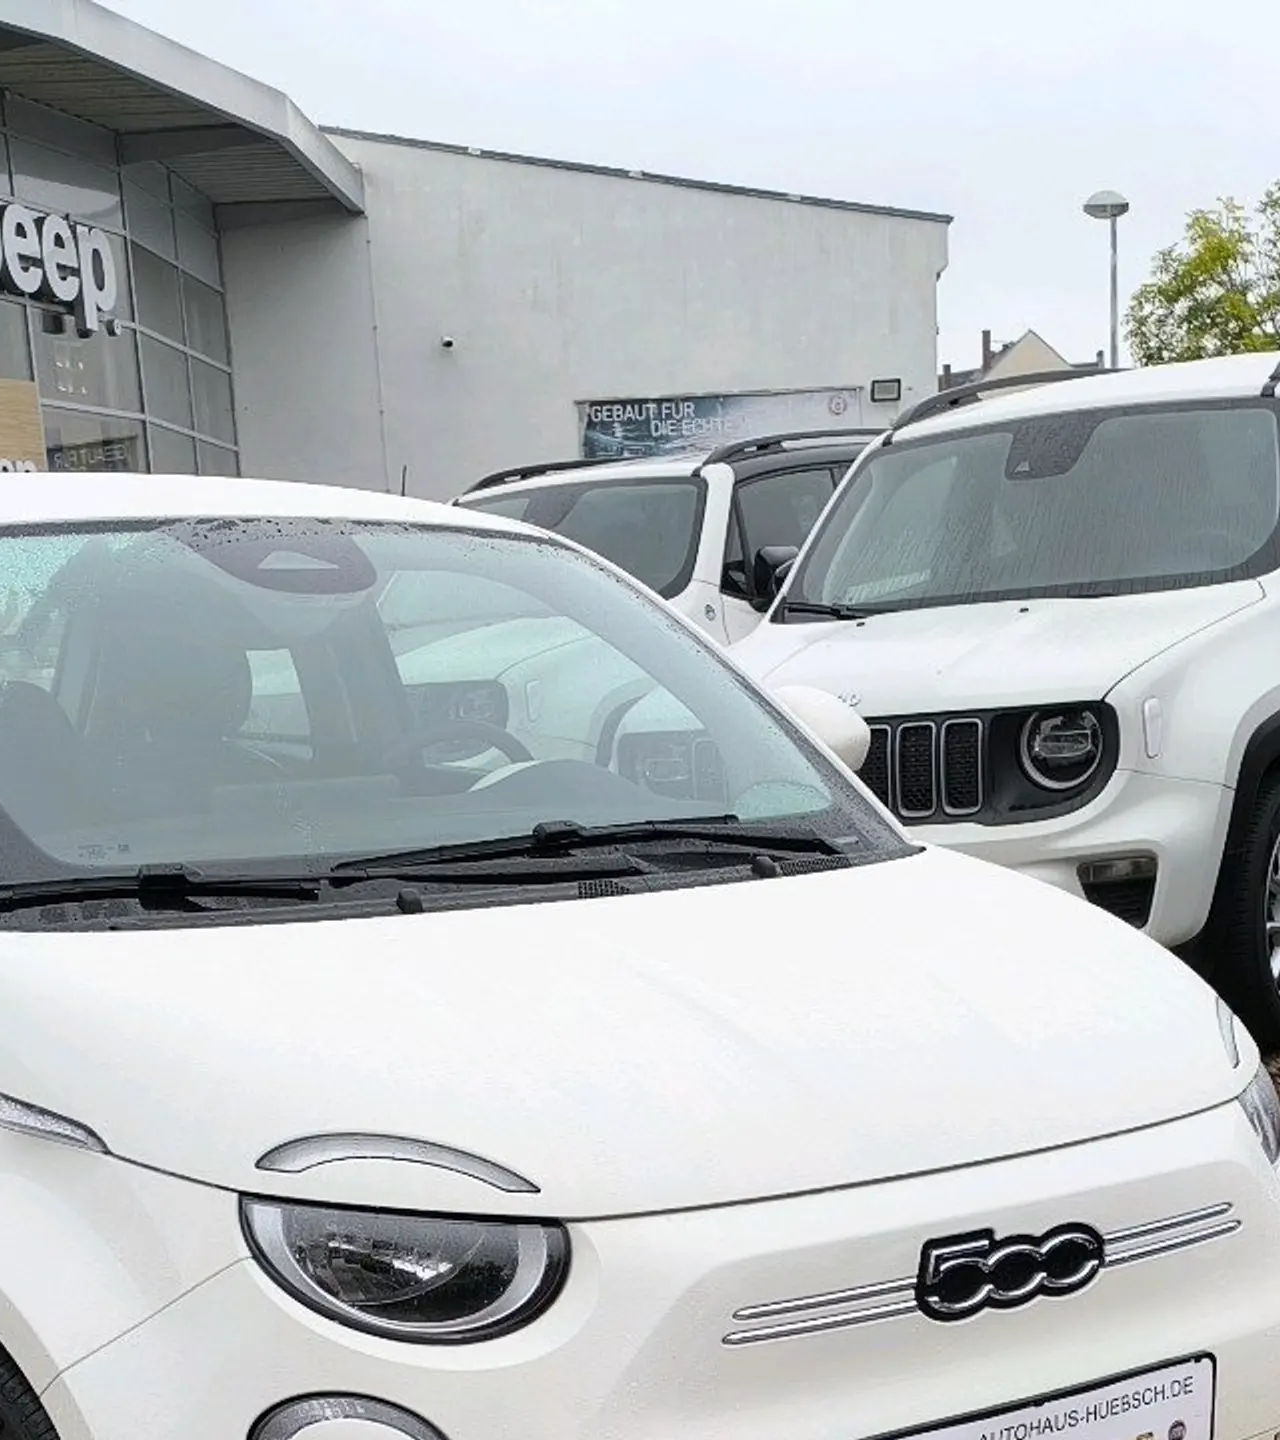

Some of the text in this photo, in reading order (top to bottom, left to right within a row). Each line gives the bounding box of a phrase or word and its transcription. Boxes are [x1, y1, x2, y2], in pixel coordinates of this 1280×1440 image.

[591, 403, 657, 422] GEBAUT
[650, 419, 677, 437] DIE
[917, 1222, 1104, 1322] 500
